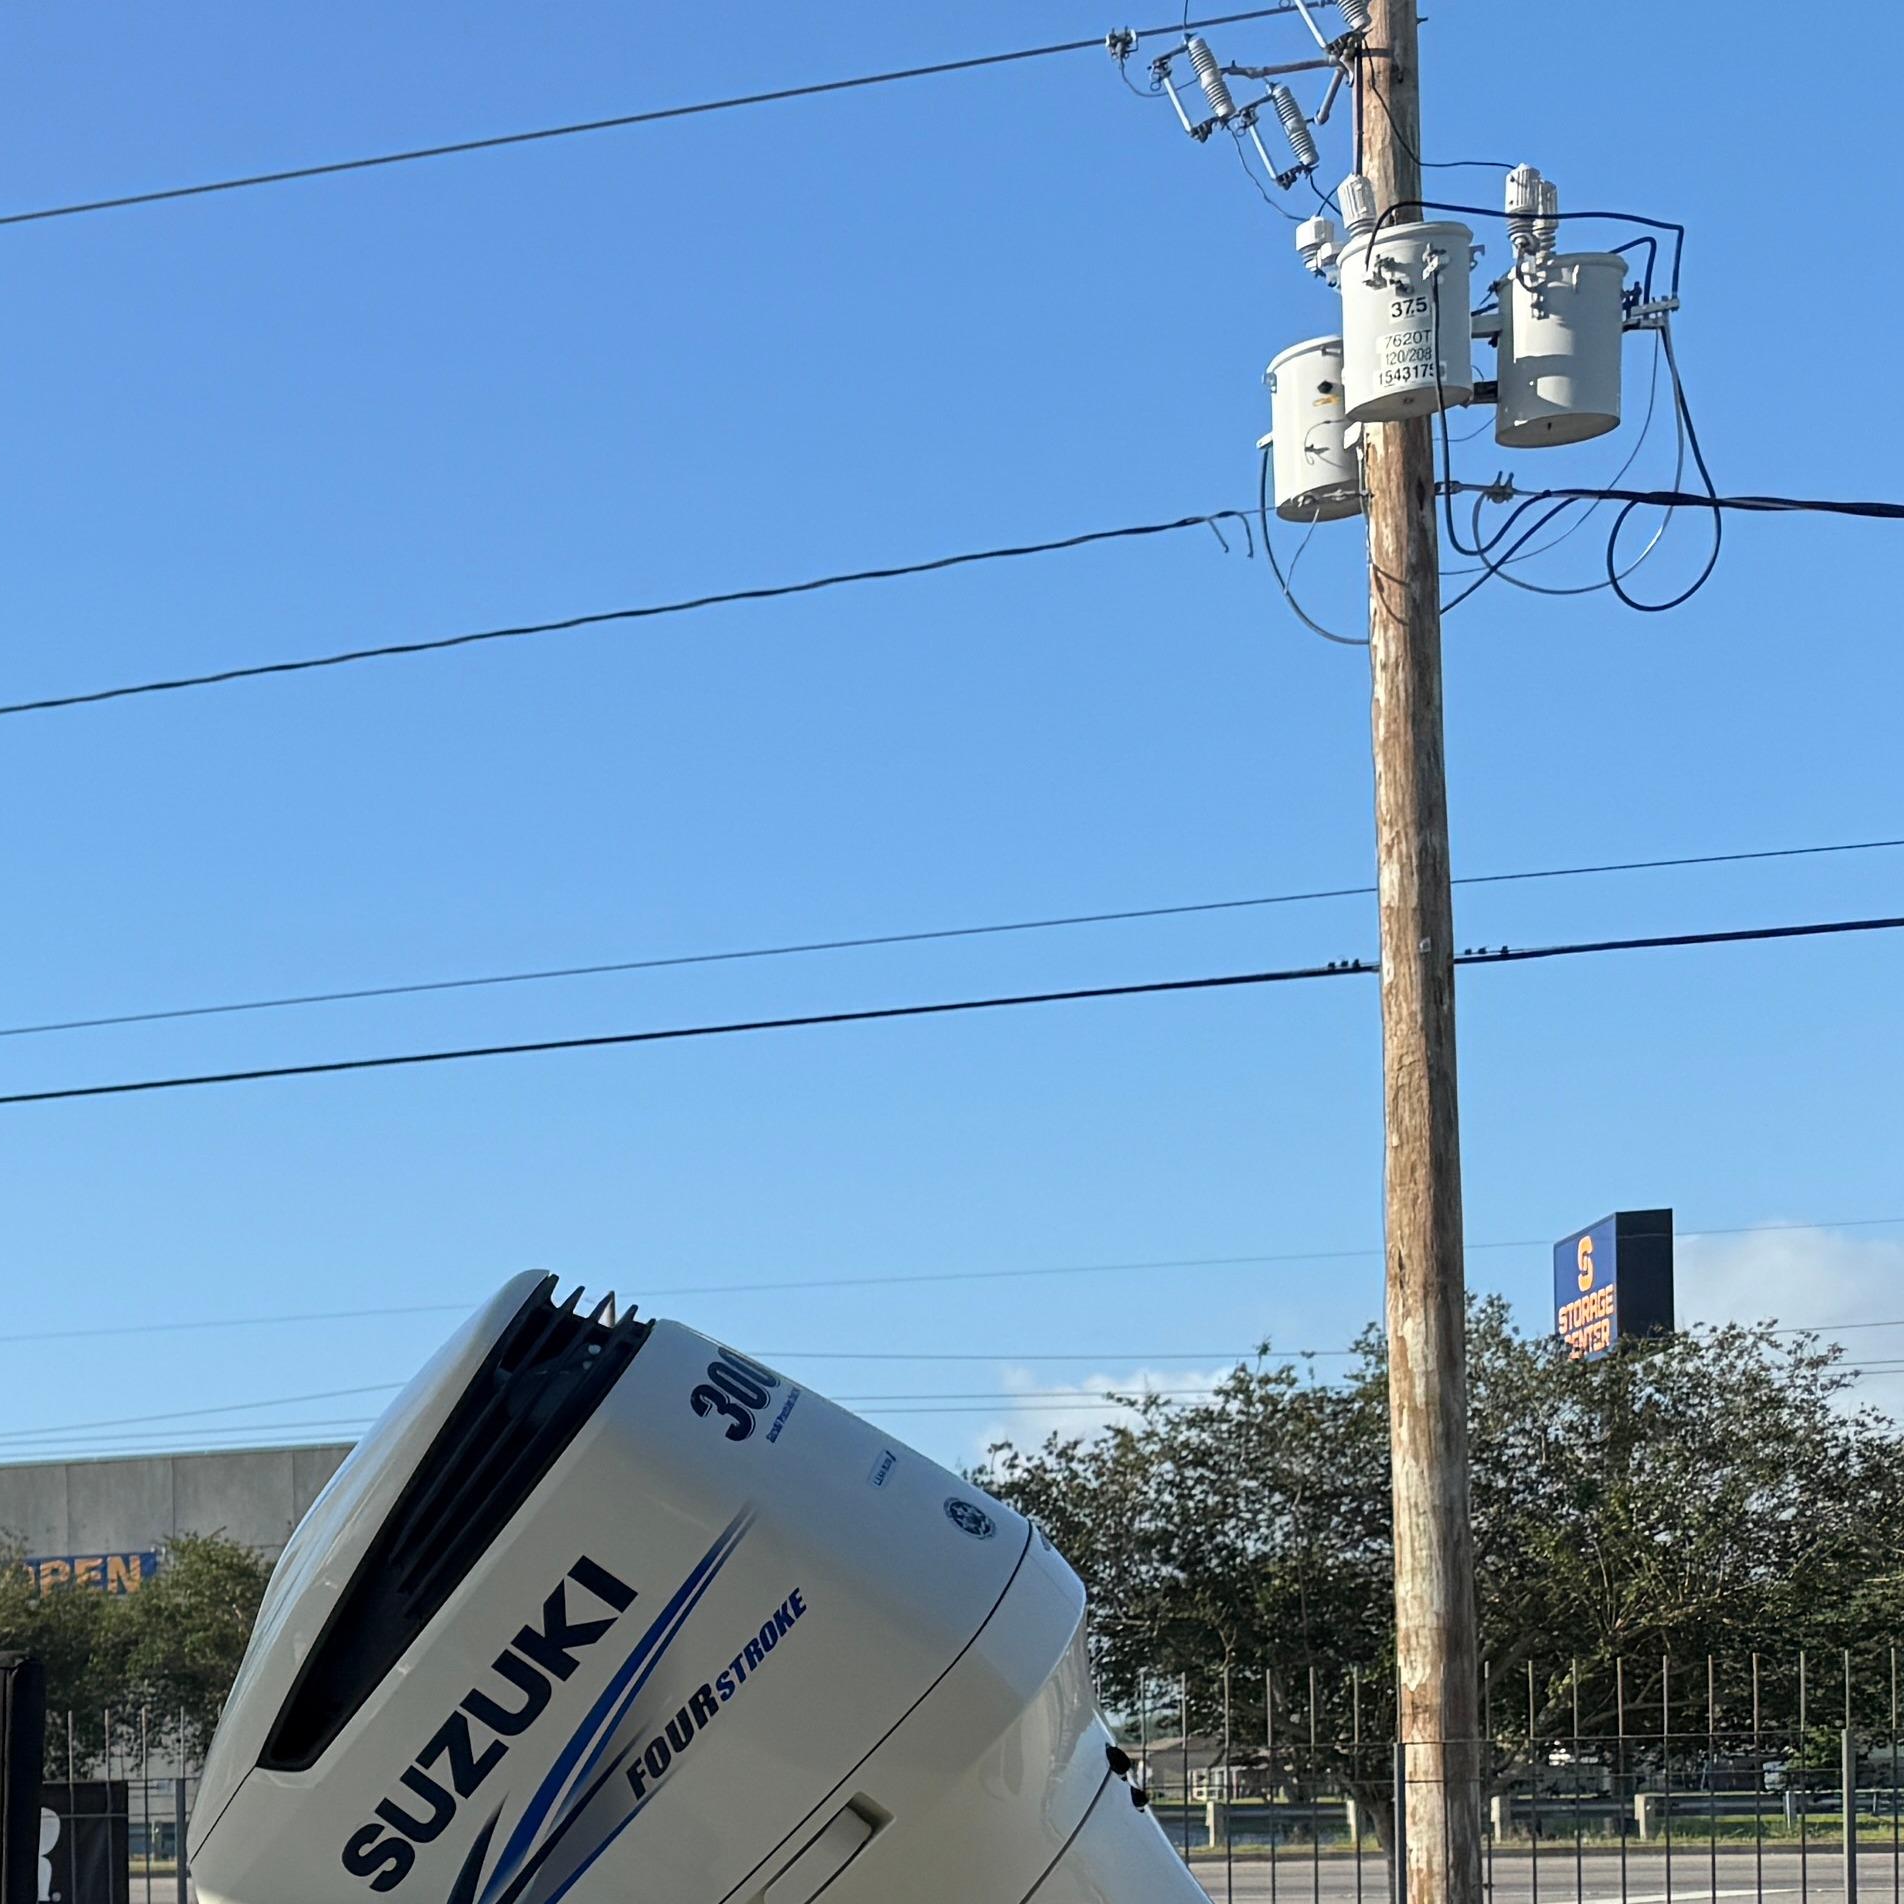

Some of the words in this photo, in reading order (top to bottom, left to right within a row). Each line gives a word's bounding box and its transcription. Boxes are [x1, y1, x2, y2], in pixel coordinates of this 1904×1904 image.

[1391, 297, 1428, 318] 37.5
[1385, 329, 1432, 349] 7620T
[1386, 347, 1432, 366] 120/208
[1558, 1283, 1615, 1335] STORAGE
[341, 1555, 639, 1893] SUZUKI
